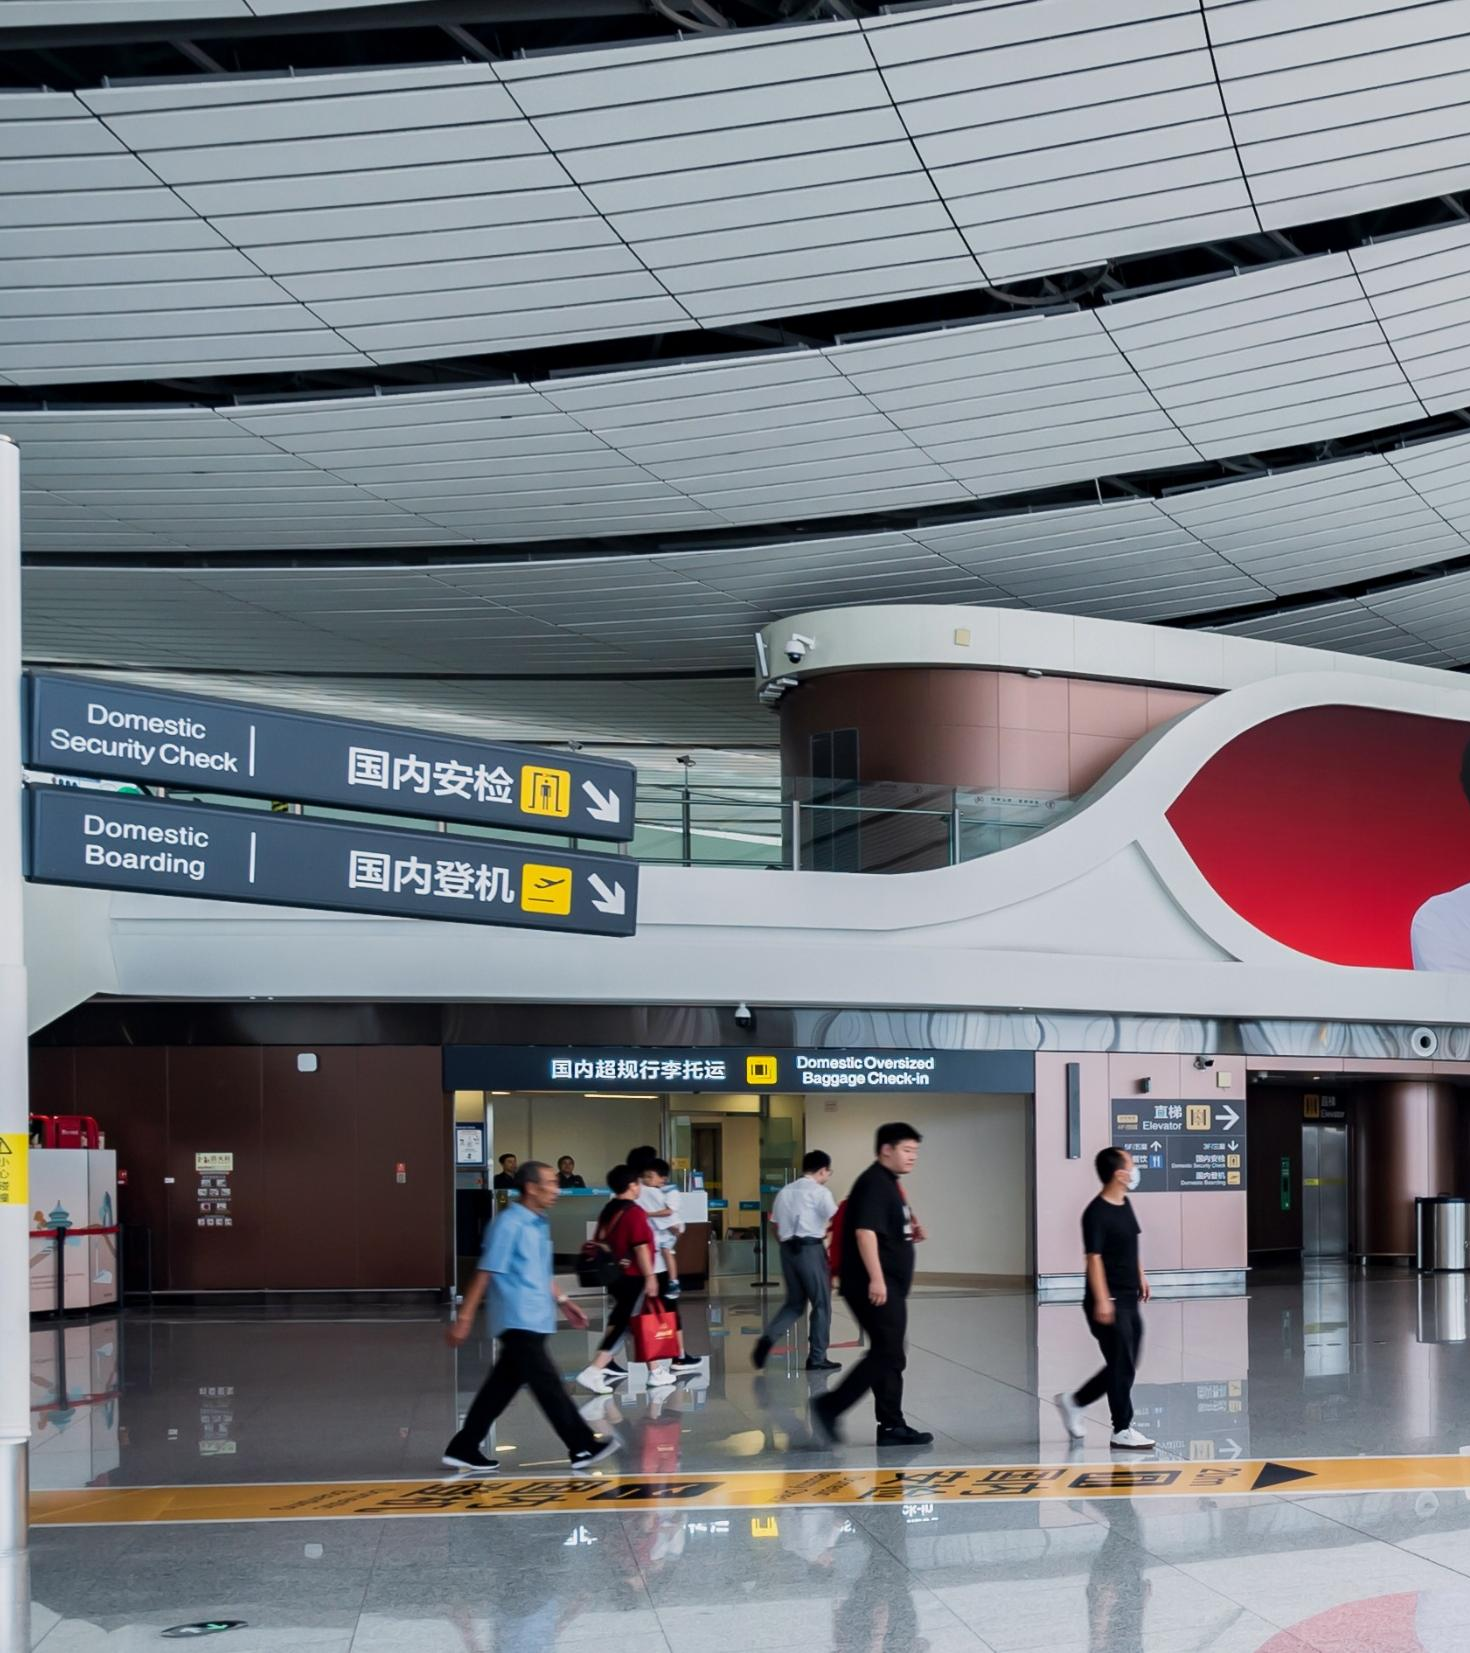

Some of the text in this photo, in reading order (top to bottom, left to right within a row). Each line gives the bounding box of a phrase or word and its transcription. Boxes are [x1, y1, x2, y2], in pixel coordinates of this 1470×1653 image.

[87, 702, 206, 741] Domestic
[50, 727, 238, 773] Security Check
[347, 745, 514, 804] 国内安检
[83, 813, 209, 848] Domestic
[84, 843, 206, 881] Boarding
[348, 849, 515, 904] 国内登机
[550, 1058, 727, 1081] 国内超规行李托运
[796, 1054, 935, 1071] Domestic Oversized
[802, 1070, 929, 1087] Baggage Check-in
[1142, 1121, 1182, 1131] Elevator
[1154, 1105, 1182, 1119] 直梯
